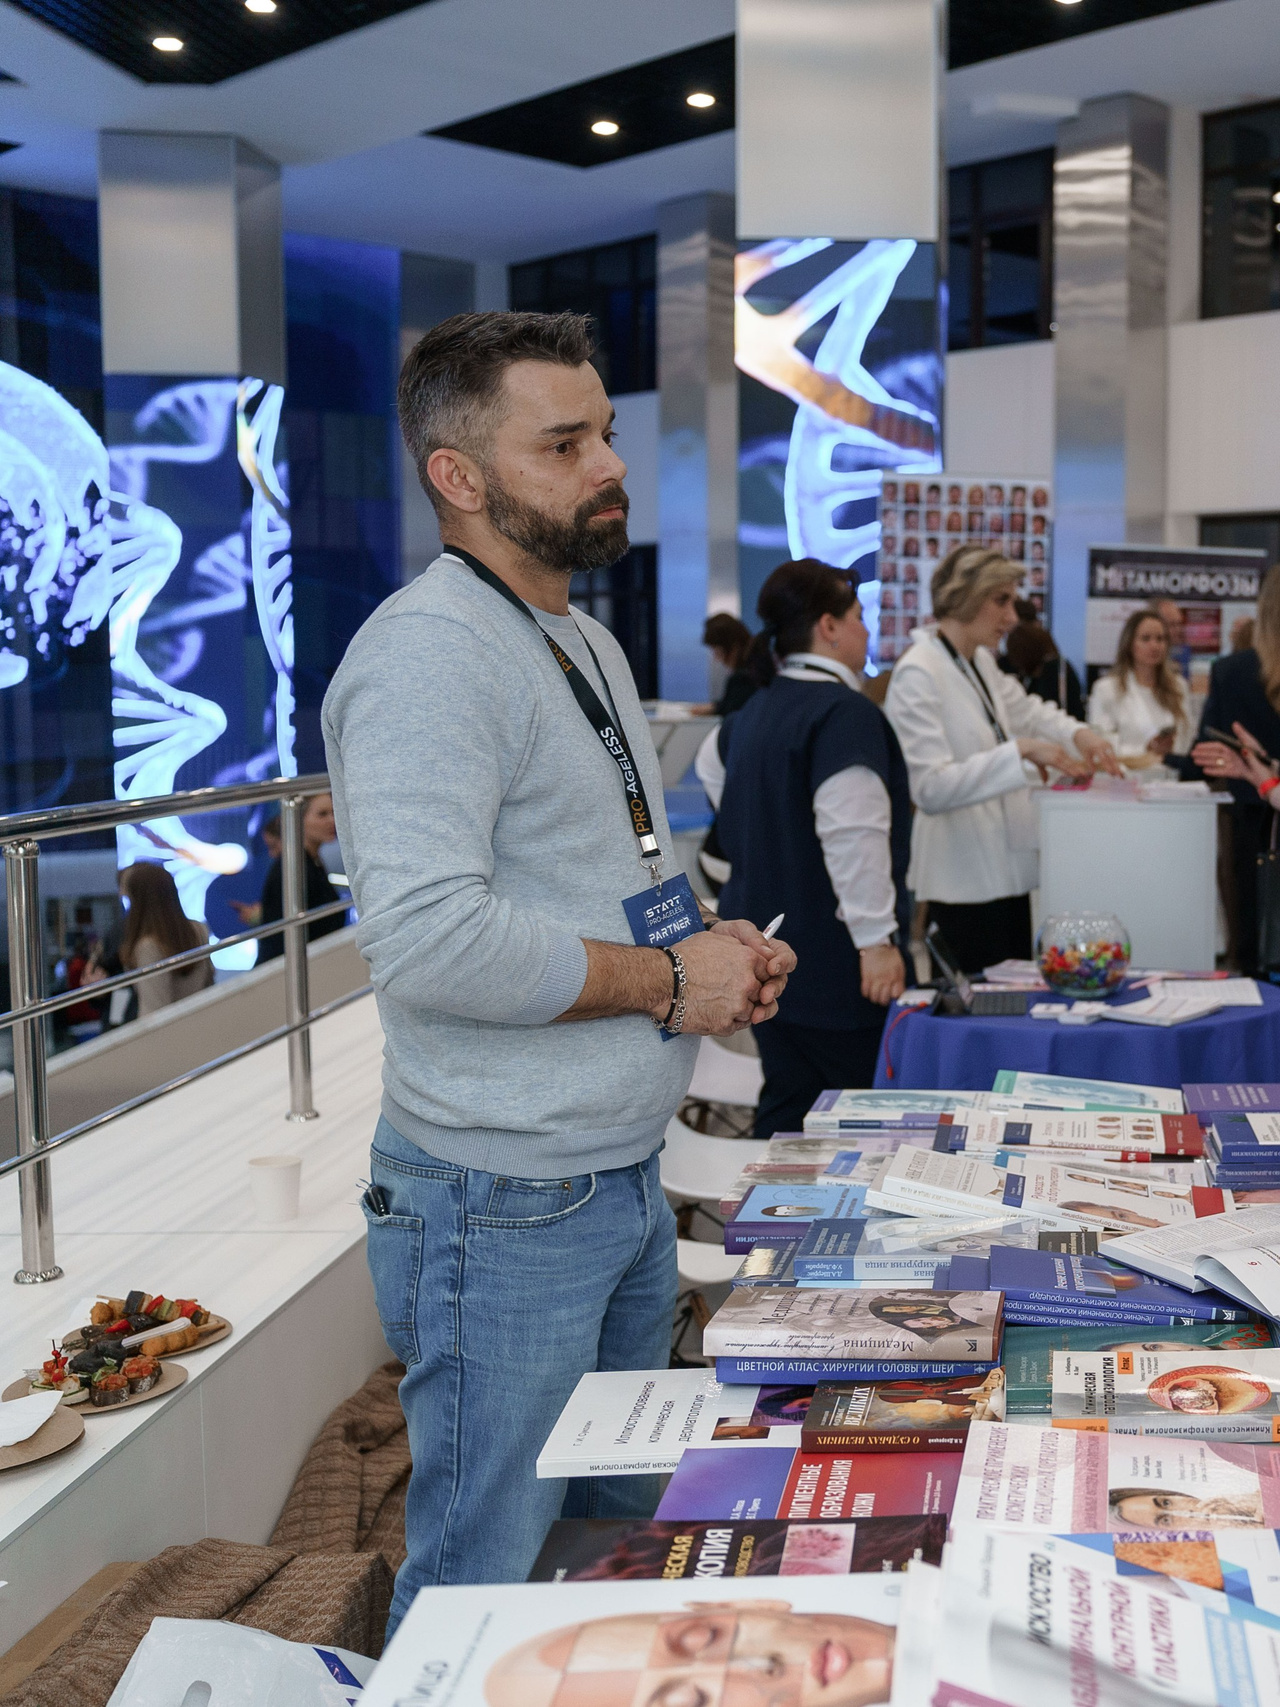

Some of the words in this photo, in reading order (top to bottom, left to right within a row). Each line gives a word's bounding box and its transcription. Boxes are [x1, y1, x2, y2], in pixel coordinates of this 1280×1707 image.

[1095, 563, 1259, 597] МЕТАМОРФОЗЫ
[600, 726, 650, 834] PRO-AGELESS
[646, 895, 681, 918] START
[649, 905, 685, 926] PRO-AGELESS
[649, 917, 691, 944] PARTNER
[865, 1261, 889, 1269] лица
[890, 1260, 935, 1269] хирургия
[1029, 1292, 1065, 1302] процедур
[1065, 1296, 1119, 1308] косметических
[1023, 1303, 1076, 1314] косметических
[1120, 1302, 1165, 1312] осложнений
[1166, 1306, 1196, 1316] Лечение
[1004, 1313, 1058, 1325] косметических
[1078, 1309, 1122, 1319] осложнений
[1124, 1313, 1155, 1323] Лечение
[843, 1339, 914, 1352] Медицина
[737, 1361, 784, 1373] ЦВЕТНОЙ
[787, 1362, 820, 1372] АТЛАС
[822, 1362, 875, 1373] ХИРУРГИИ
[878, 1363, 919, 1373] ГОЛОВЫ
[922, 1363, 929, 1373] И
[932, 1363, 954, 1374] ШЕИ
[1121, 1357, 1130, 1371] Атлас
[1101, 1357, 1119, 1415] патофизиология
[1081, 1372, 1097, 1415] Клиническая
[614, 1380, 657, 1445] Иллюстрированная
[843, 1386, 870, 1426] ВЕЛИКИХ
[647, 1400, 676, 1443] клиническая
[677, 1394, 706, 1443] дерматология
[1114, 1427, 1137, 1435] Атлас
[1145, 1425, 1215, 1435] патофизиология
[1217, 1426, 1271, 1434] Клиническая
[816, 1435, 866, 1445] ВЕЛИКИХ
[867, 1435, 911, 1445] СУДЬБАХ
[913, 1436, 920, 1444] О
[589, 1462, 651, 1473] дерматология
[787, 1464, 823, 1519] ПИГМЕНТНЫЕ
[819, 1460, 853, 1518] ОБРАЗОВАНИЯ
[851, 1493, 876, 1518] КОЖИ
[693, 1529, 733, 1580] КОПИЯ
[1027, 1553, 1052, 1647] ИСКУССТВО
[1101, 1579, 1137, 1679] КОНТУРНОЙ
[1147, 1592, 1180, 1682] ПЛАСТИКИ
